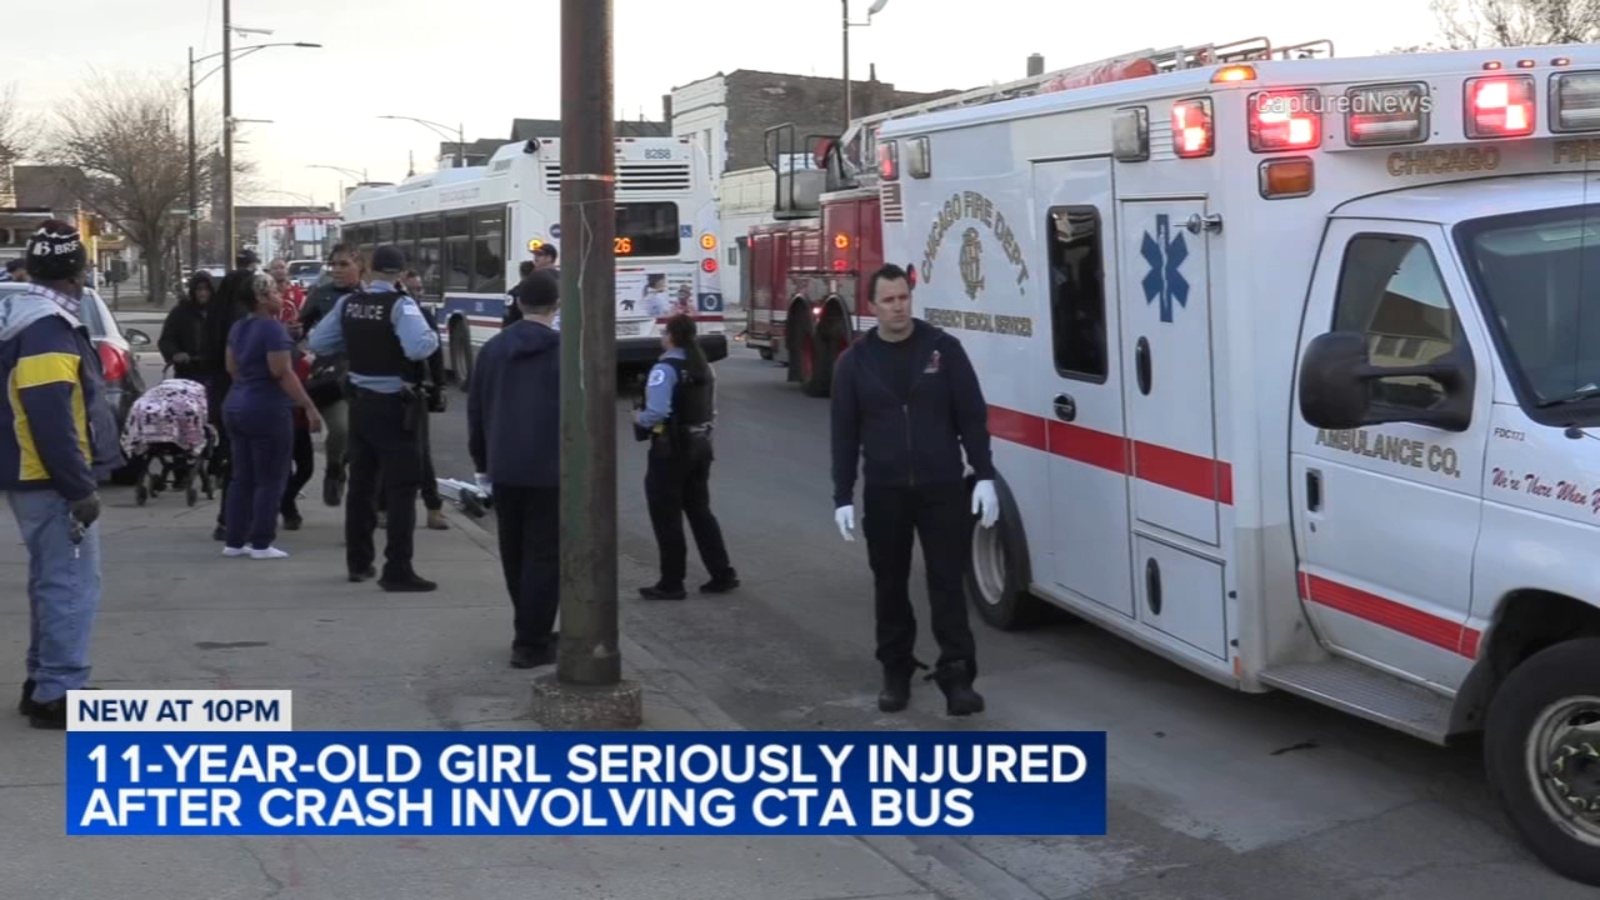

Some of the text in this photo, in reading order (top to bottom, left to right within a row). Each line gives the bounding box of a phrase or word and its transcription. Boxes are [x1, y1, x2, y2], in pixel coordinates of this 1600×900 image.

[1387, 145, 1500, 177] CHICAGO
[921, 193, 961, 285] CHICAGO
[963, 190, 994, 230] FIRE
[346, 302, 384, 321] POLICE
[1315, 427, 1461, 478] AMBULANCE CO.
[1492, 467, 1520, 491] We're
[1524, 473, 1553, 498] There
[1556, 480, 1587, 505] When
